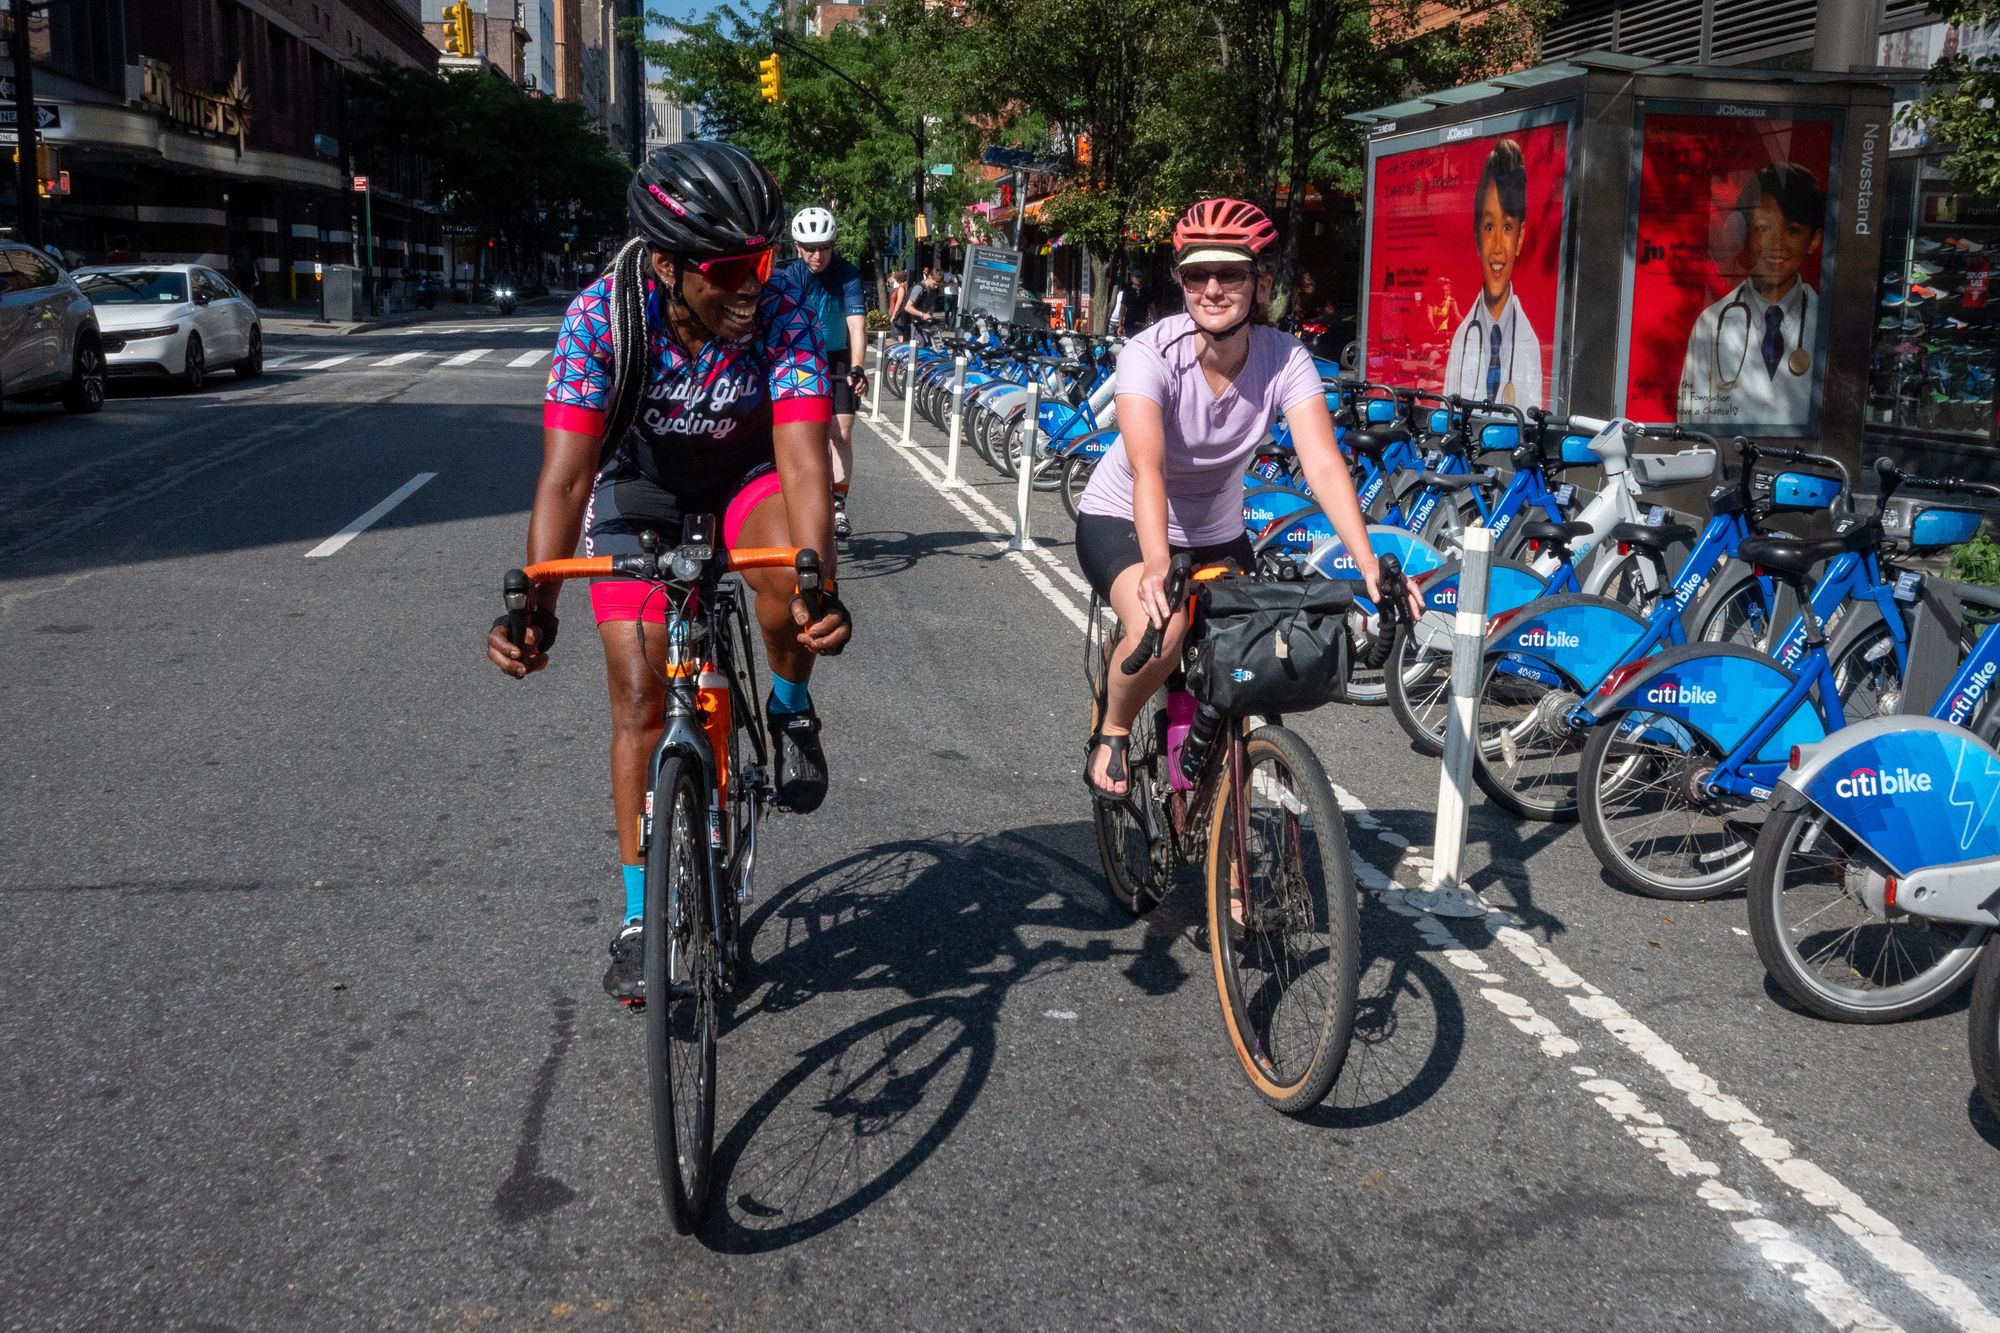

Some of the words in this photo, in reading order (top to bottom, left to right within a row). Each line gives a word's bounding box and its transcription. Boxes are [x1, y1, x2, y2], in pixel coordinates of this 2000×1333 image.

[1716, 105, 1767, 117] JCDecaux
[1446, 127, 1473, 140] JCDecaux
[1856, 123, 1880, 235] Newsstand
[745, 236, 766, 246] GIRO
[710, 376, 757, 412] Girl
[1690, 391, 1731, 402] Foundation
[643, 408, 737, 439] Cycling
[1368, 478, 1383, 500] bike
[1251, 508, 1274, 520] bike
[1419, 498, 1435, 522] bike
[1287, 531, 1306, 542] citi
[1306, 530, 1331, 542] bike
[1433, 590, 1456, 604] citi
[1676, 573, 1701, 607] bike
[1518, 632, 1545, 648] citi
[1546, 631, 1579, 648] bike
[1647, 683, 1676, 704] citi
[1678, 685, 1718, 705] bike
[1949, 694, 1974, 726] citi
[1963, 660, 1998, 699] bike
[1835, 769, 1878, 799] citi
[1879, 767, 1932, 795] bike
